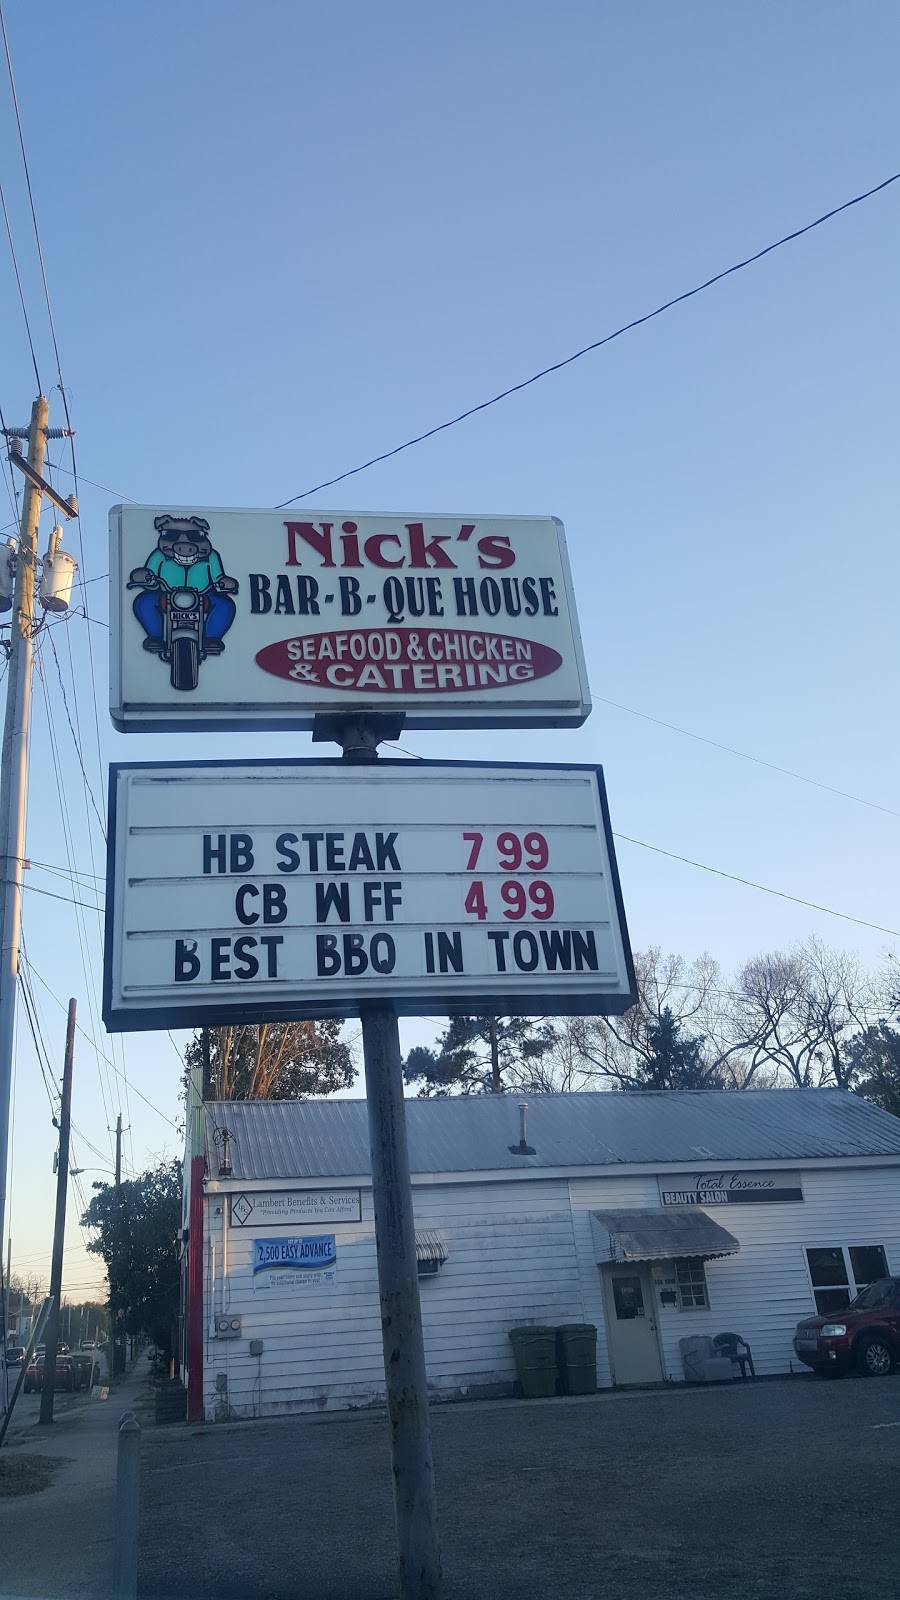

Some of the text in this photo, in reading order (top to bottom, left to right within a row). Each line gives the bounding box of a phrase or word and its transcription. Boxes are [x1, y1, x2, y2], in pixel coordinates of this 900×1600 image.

[283, 521, 516, 569] Nick's
[453, 576, 559, 617] HOUSE
[172, 612, 198, 620] NICK'S
[287, 631, 532, 661] SEAFOOD & CHICKEN
[289, 662, 534, 689] & CATERING
[203, 833, 254, 874] HB
[276, 832, 402, 873] STEAK
[235, 882, 288, 925] CB
[174, 930, 599, 982] BEST BBQ IN TOWN
[693, 1174, 775, 1190] Total Essence
[252, 1195, 359, 1208] Lambert Benefits & Services
[664, 1190, 728, 1204] BEAUTY SALON
[281, 1244, 298, 1259] EASY
[300, 1242, 332, 1258] ADVANCE
